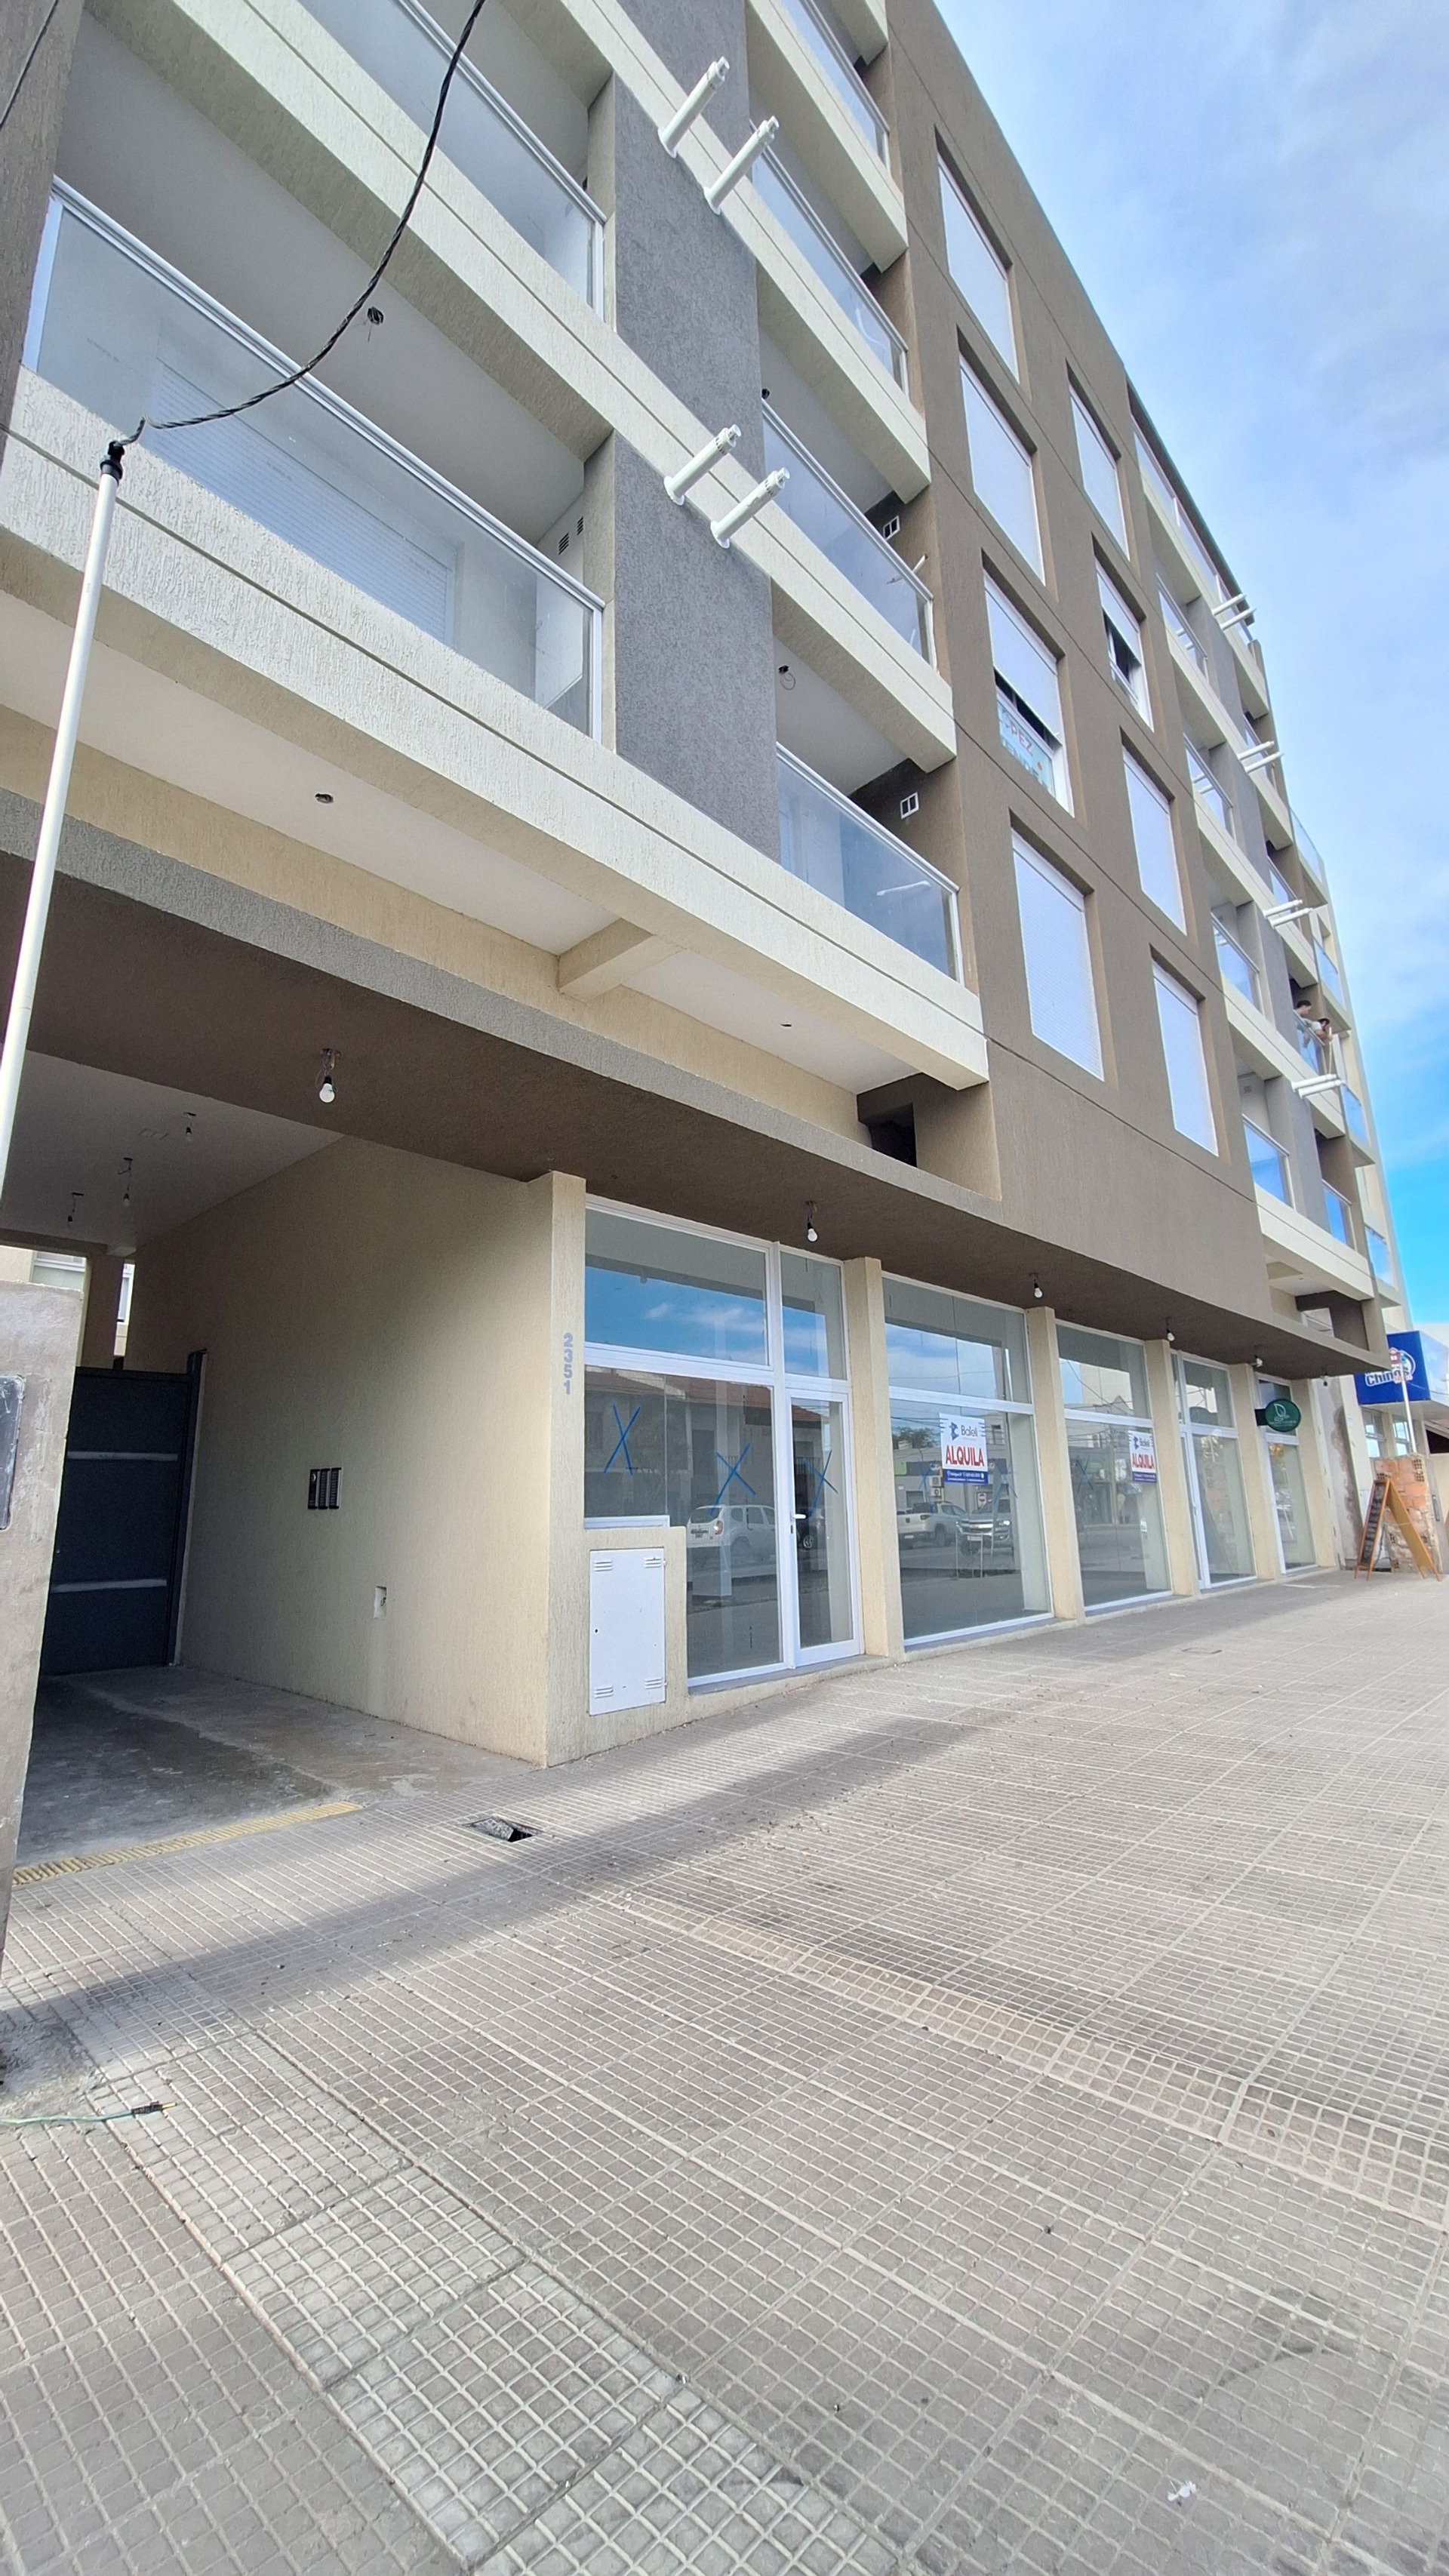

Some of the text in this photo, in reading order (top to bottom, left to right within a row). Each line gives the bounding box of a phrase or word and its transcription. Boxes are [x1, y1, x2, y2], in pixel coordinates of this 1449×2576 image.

[563, 1332, 574, 1395] 2351
[946, 1445, 984, 1467] ALQUILA
[1132, 1453, 1155, 1470] ALQUILA
